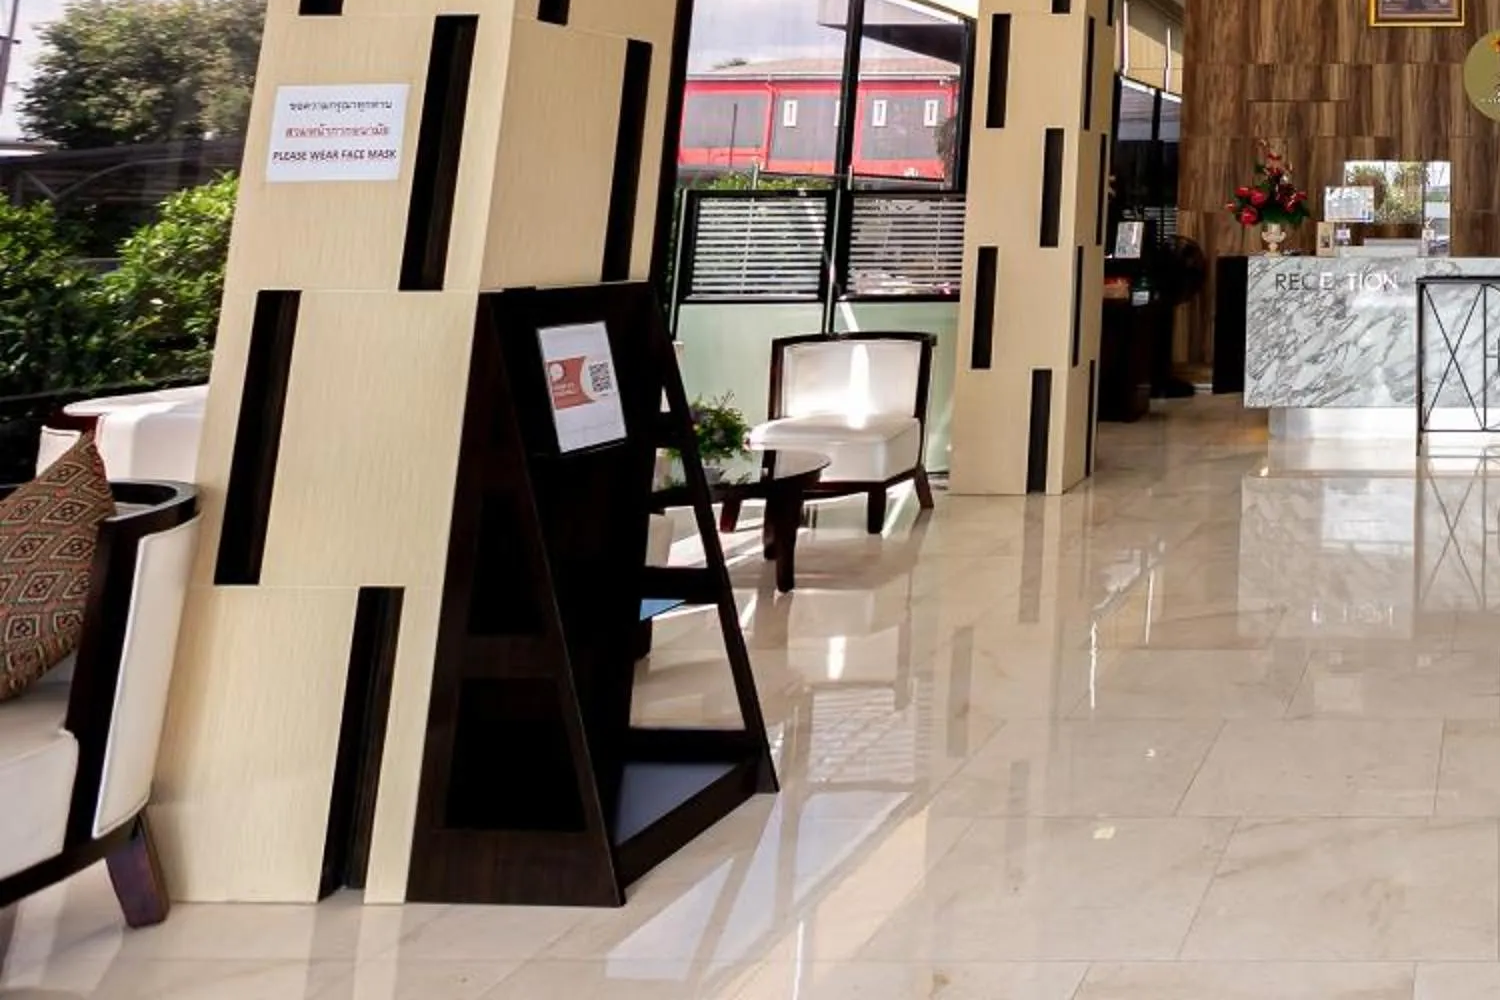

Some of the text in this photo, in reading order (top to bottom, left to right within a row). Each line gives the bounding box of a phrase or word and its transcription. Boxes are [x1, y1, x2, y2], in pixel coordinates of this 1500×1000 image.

[272, 148, 397, 161] PLEASE WEAR FACE MASK
[1275, 271, 1399, 291] RECETION
